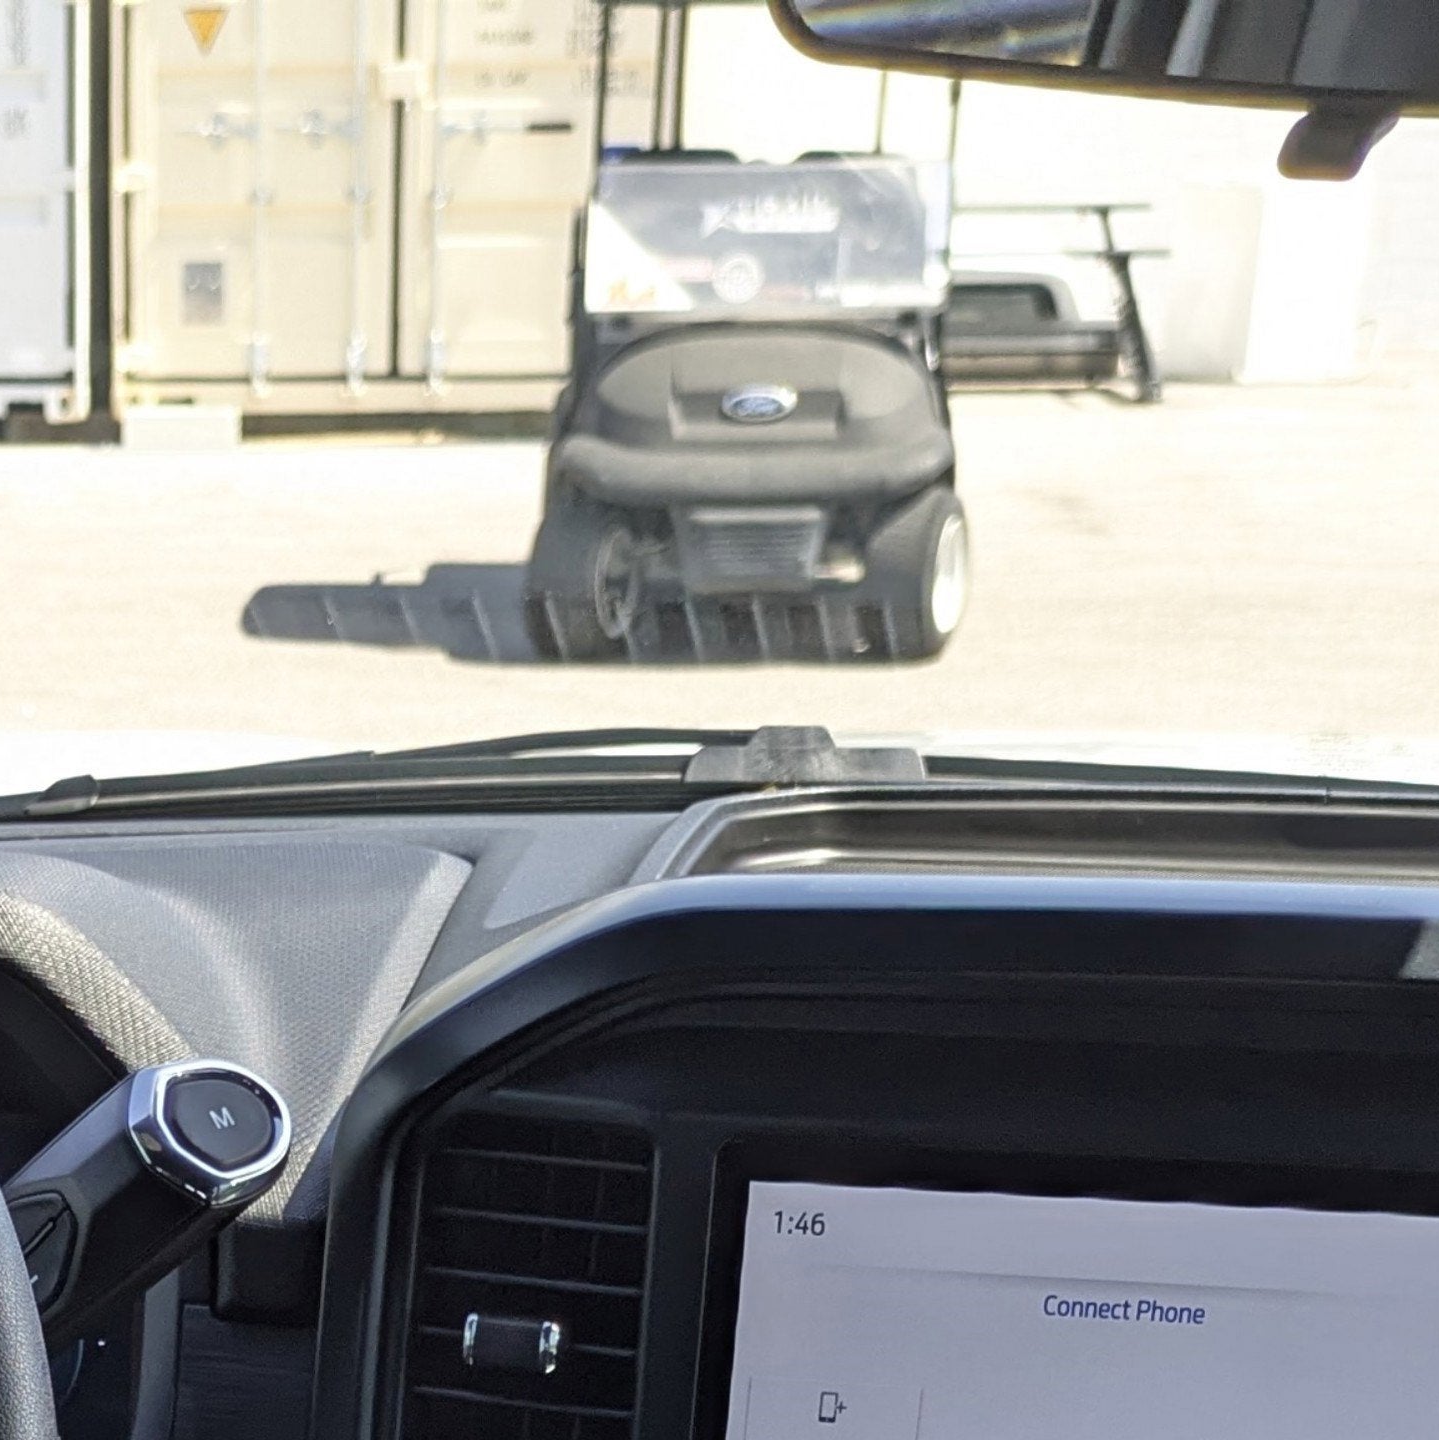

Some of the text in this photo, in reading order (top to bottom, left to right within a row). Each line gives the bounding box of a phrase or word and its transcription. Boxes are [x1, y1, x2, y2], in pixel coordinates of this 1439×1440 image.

[209, 1106, 236, 1130] M
[772, 1209, 826, 1238] 1:46
[1042, 1294, 1207, 1326] Connect Phone
